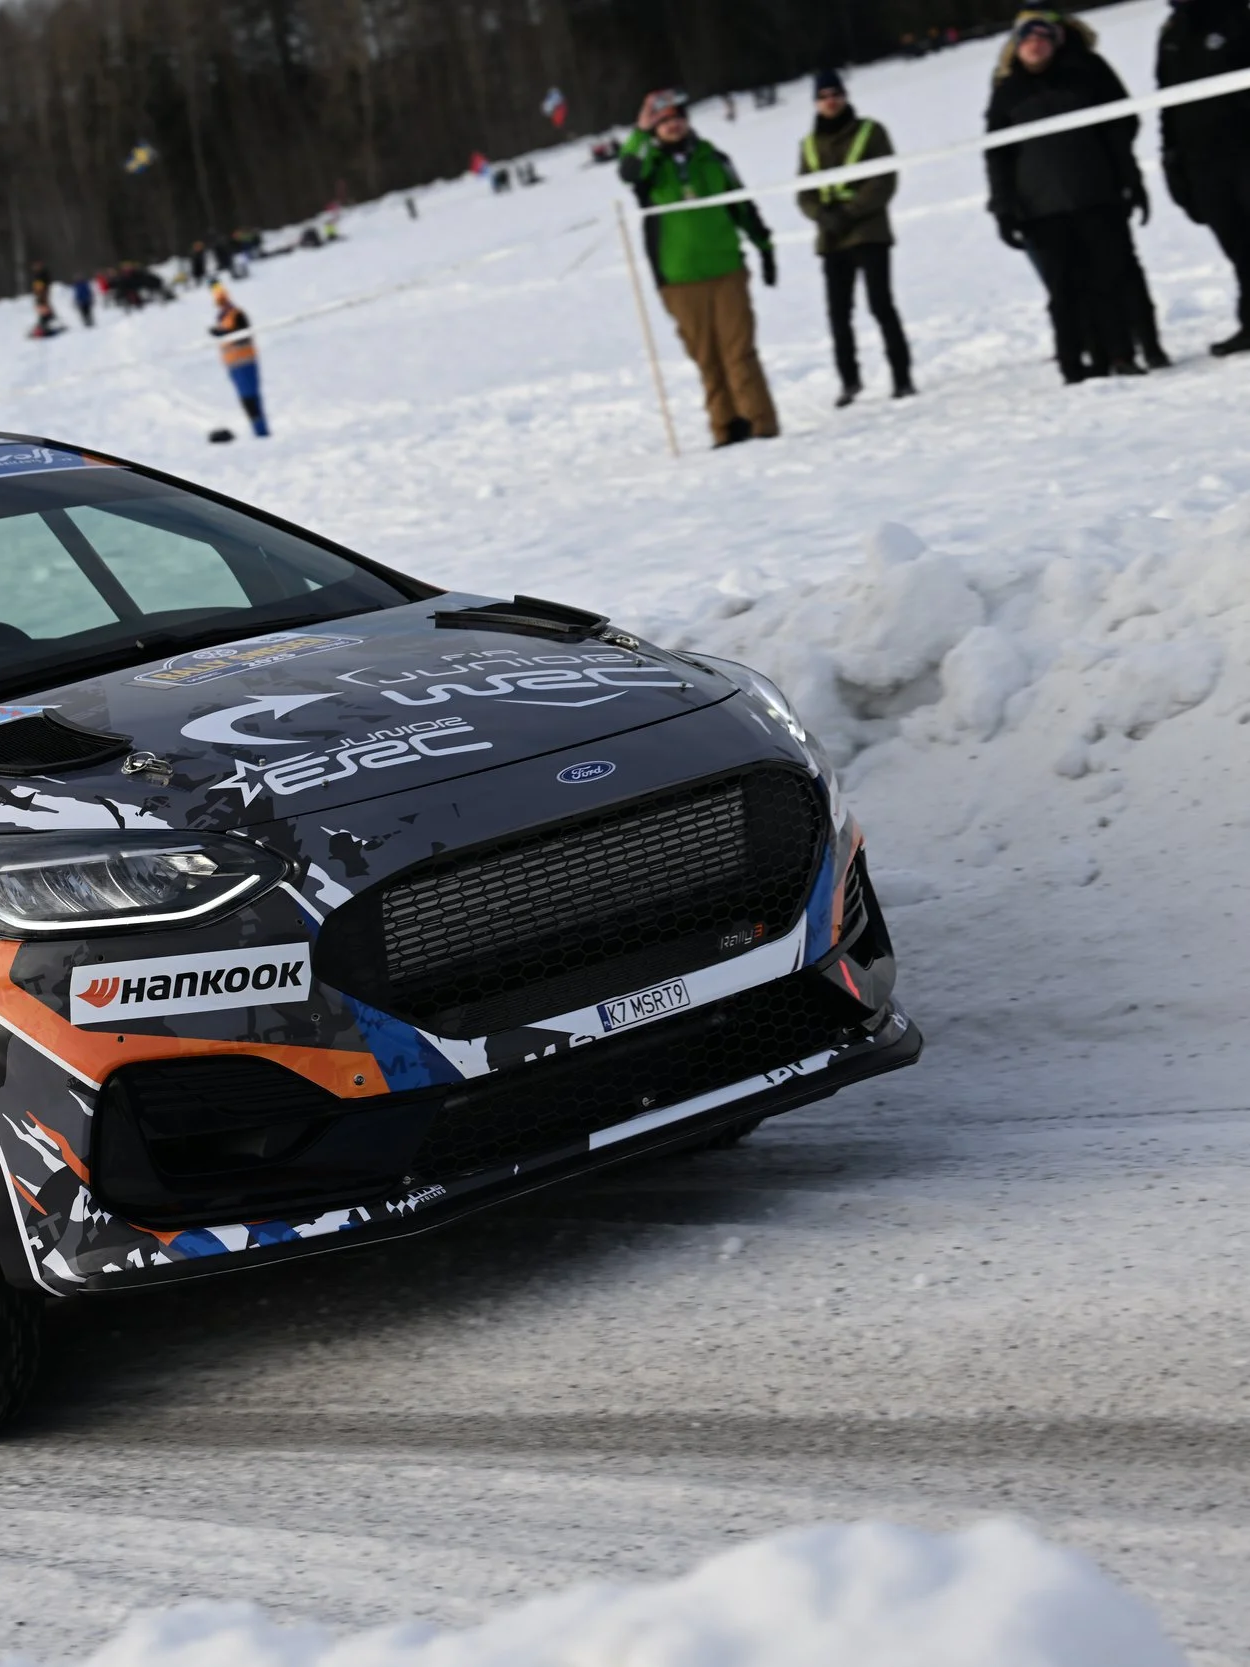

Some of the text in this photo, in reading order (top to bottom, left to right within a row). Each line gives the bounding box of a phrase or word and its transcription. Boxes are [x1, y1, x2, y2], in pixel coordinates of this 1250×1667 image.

[152, 660, 232, 681] RALLY
[228, 636, 333, 661] SWEDEN
[378, 653, 635, 684] JUNIOR
[440, 649, 519, 661] FIA
[380, 667, 695, 706] WRC
[325, 716, 468, 753] JUNIOR
[571, 765, 604, 780] Ford
[120, 960, 305, 1004] HANKOOK
[607, 984, 683, 1026] K7 MSRT9
[419, 1188, 447, 1203] POLAND
